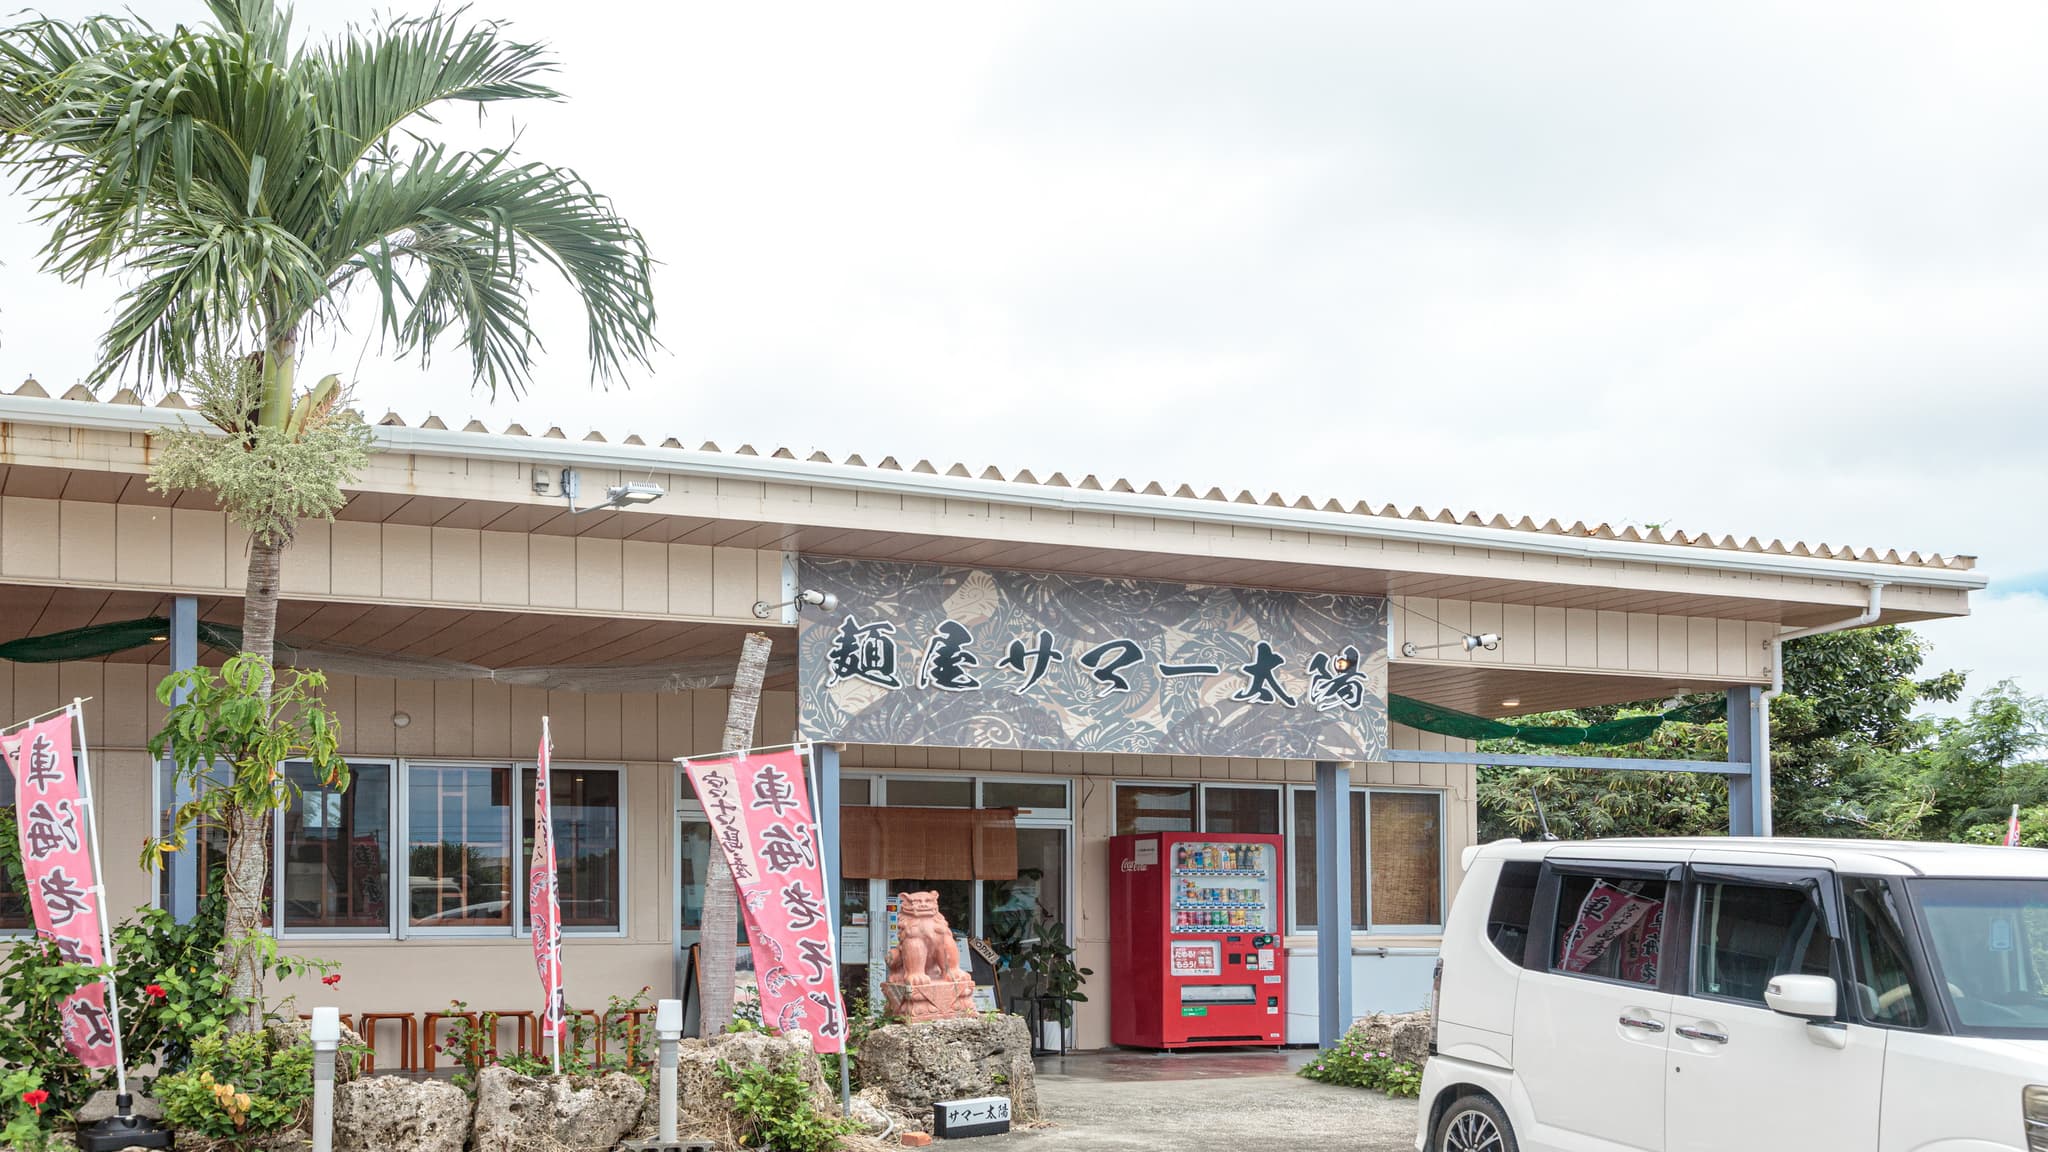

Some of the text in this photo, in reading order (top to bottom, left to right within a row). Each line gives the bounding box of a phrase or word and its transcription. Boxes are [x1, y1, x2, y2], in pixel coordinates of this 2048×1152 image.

[975, 941, 995, 959] OPEN
[949, 1103, 1009, 1123] サマー太陽
